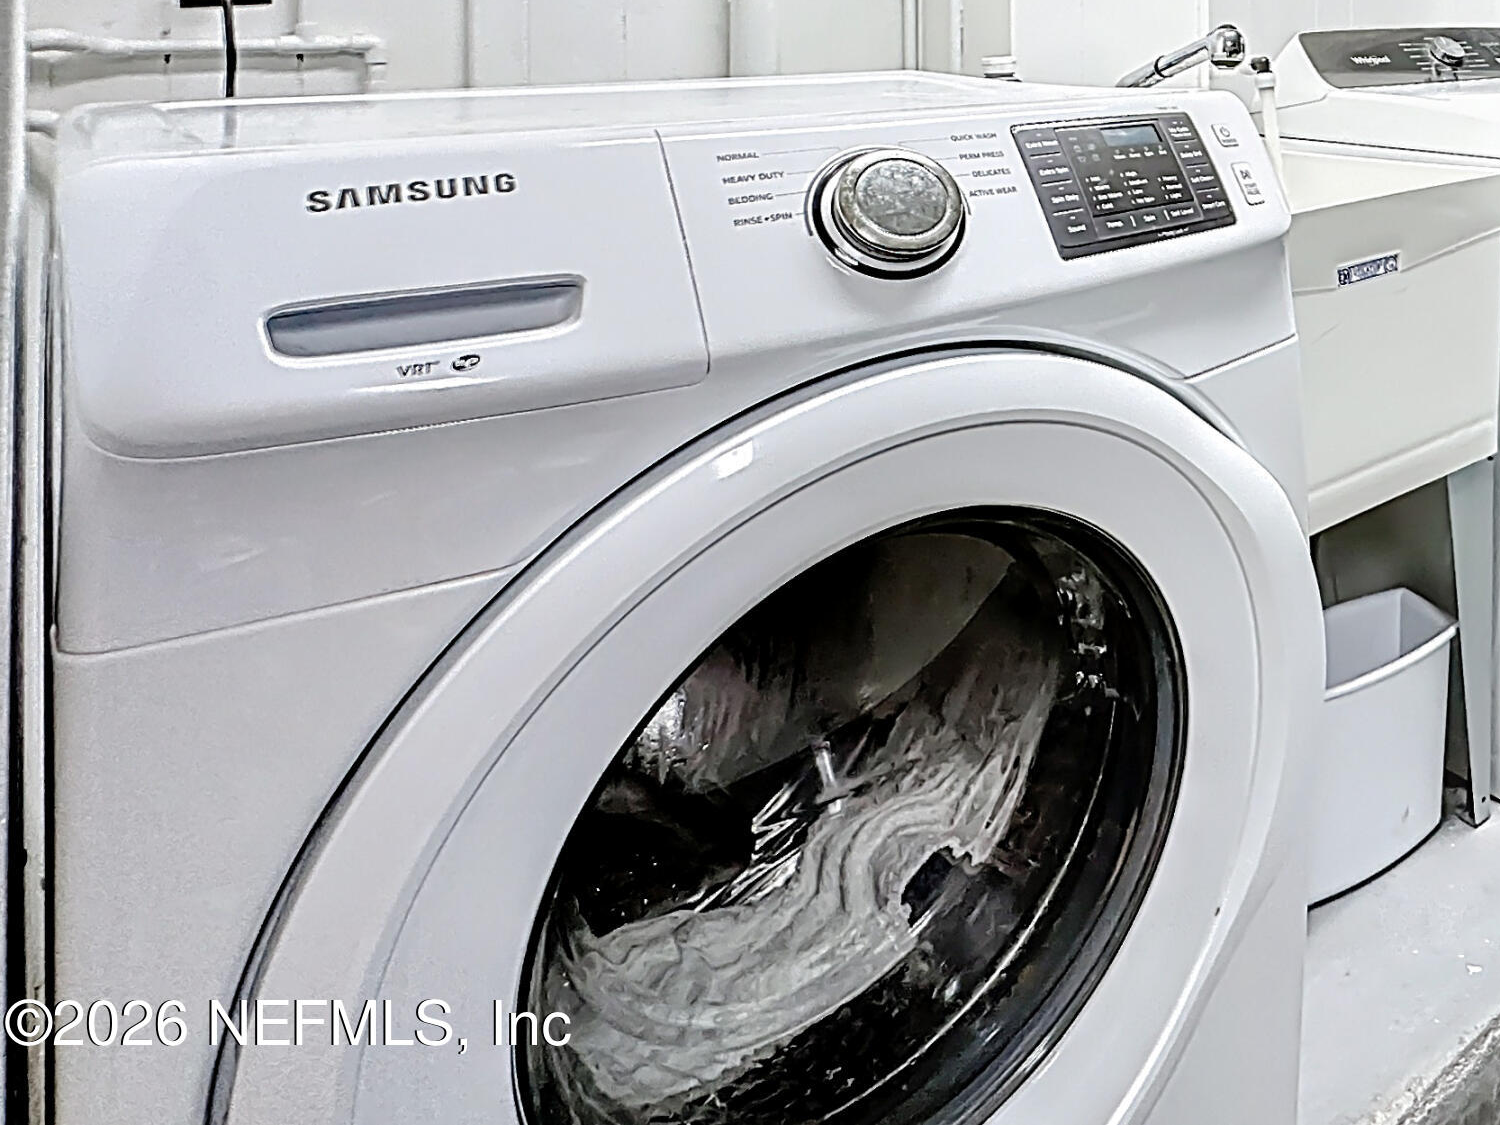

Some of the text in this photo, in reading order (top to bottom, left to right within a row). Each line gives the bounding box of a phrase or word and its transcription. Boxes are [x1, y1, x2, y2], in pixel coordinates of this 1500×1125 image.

[1350, 55, 1391, 66] Whirlpool
[950, 134, 973, 142] QUICK
[716, 152, 760, 162] NORMAL
[722, 171, 785, 184] HEAVY DUTY
[972, 168, 1011, 177] DELICATES
[306, 173, 517, 213] SAMSUNG
[969, 186, 1018, 197] ACTIVE WEAR
[728, 193, 773, 205] BEDDING
[396, 361, 436, 376] VRT
